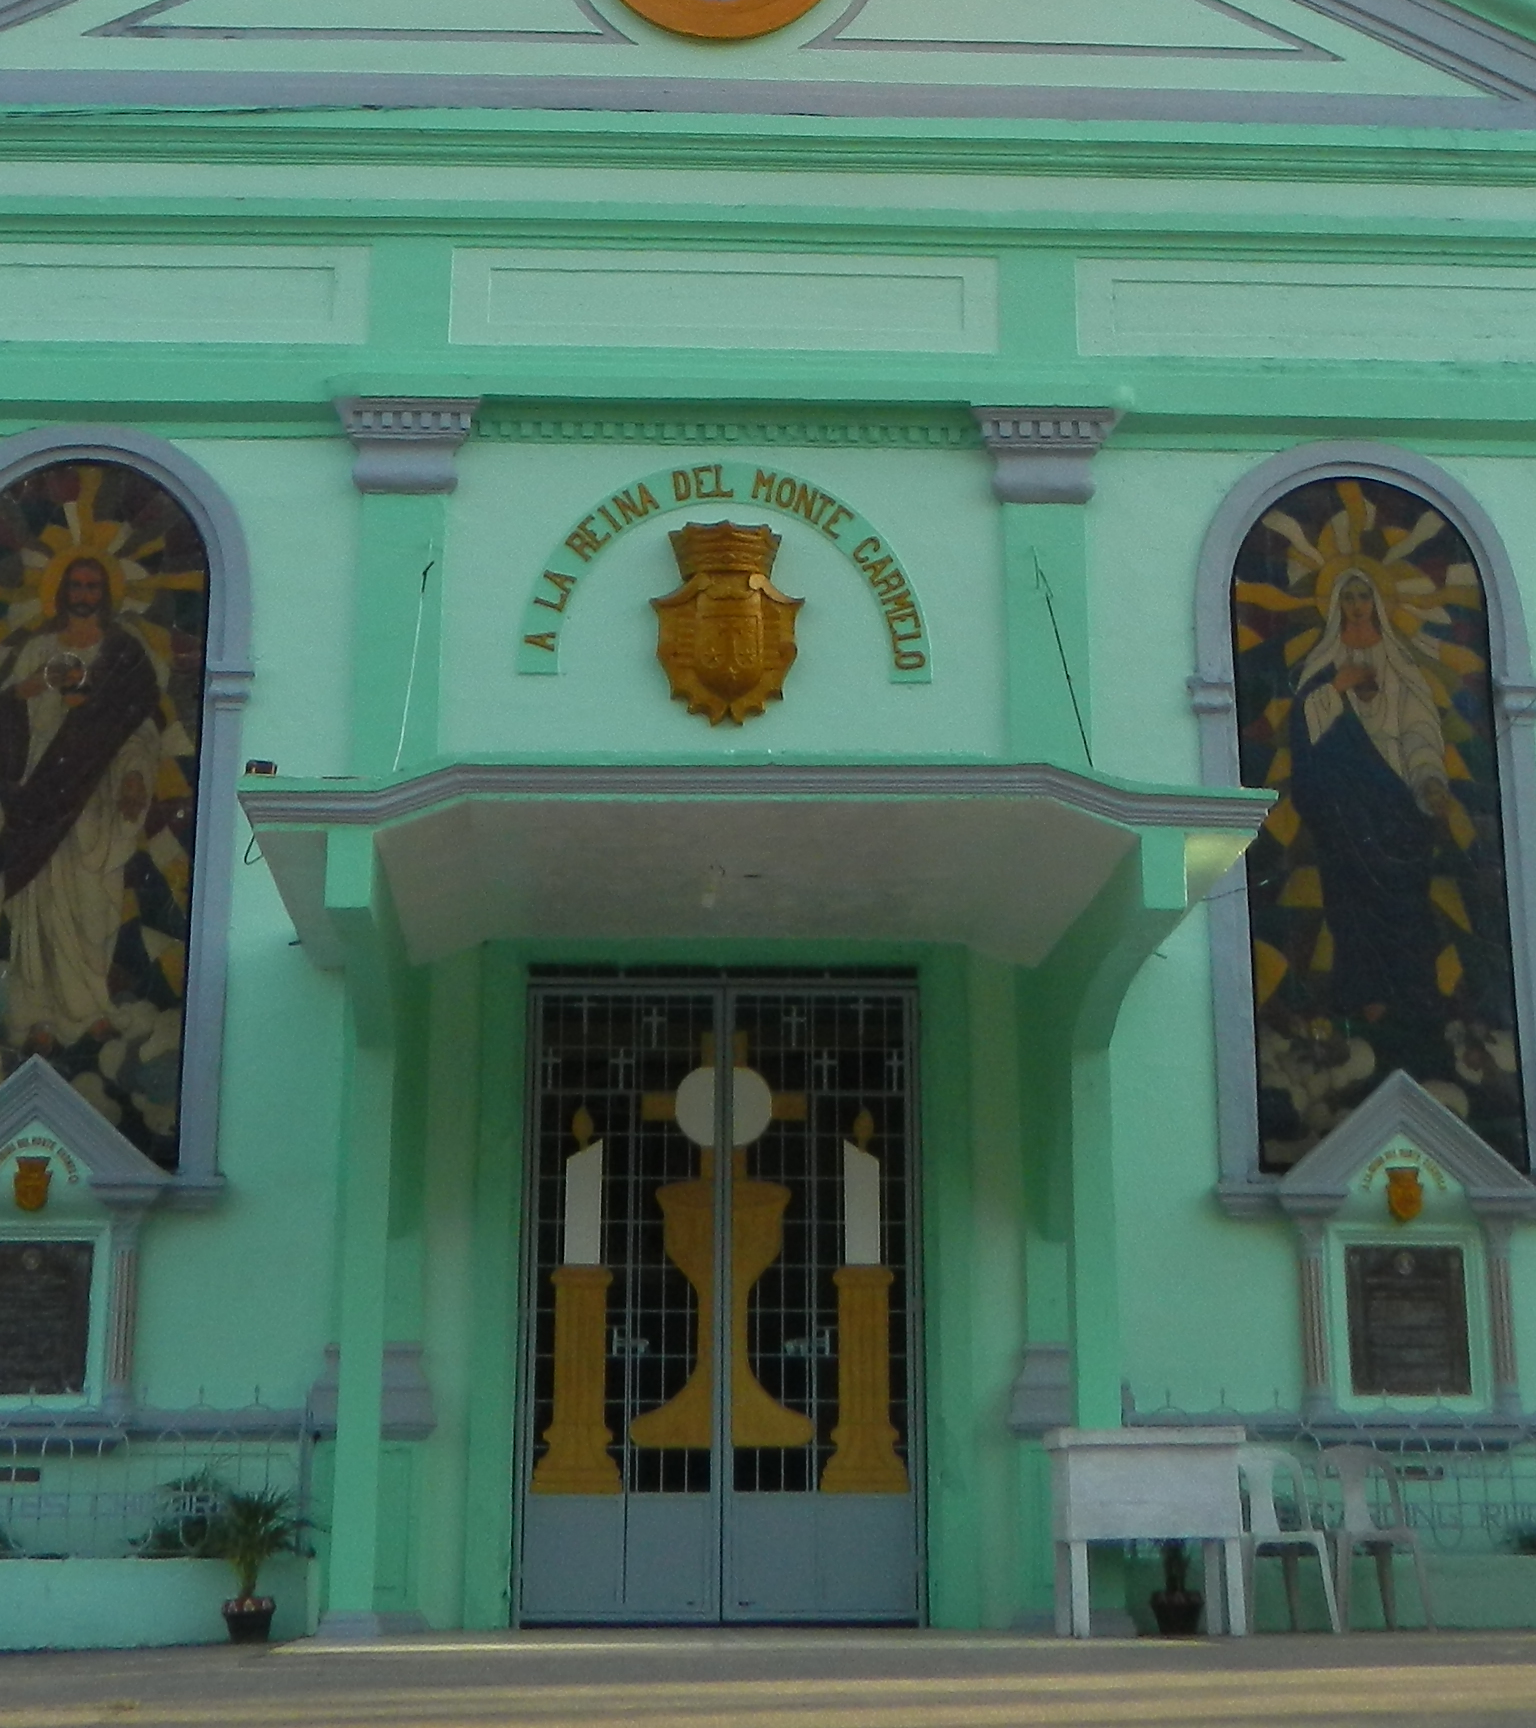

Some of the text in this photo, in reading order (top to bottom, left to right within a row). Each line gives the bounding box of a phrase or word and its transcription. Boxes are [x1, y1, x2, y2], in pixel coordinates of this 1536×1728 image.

[524, 464, 926, 671] A LA REINA DEL MONTE CARMELO
